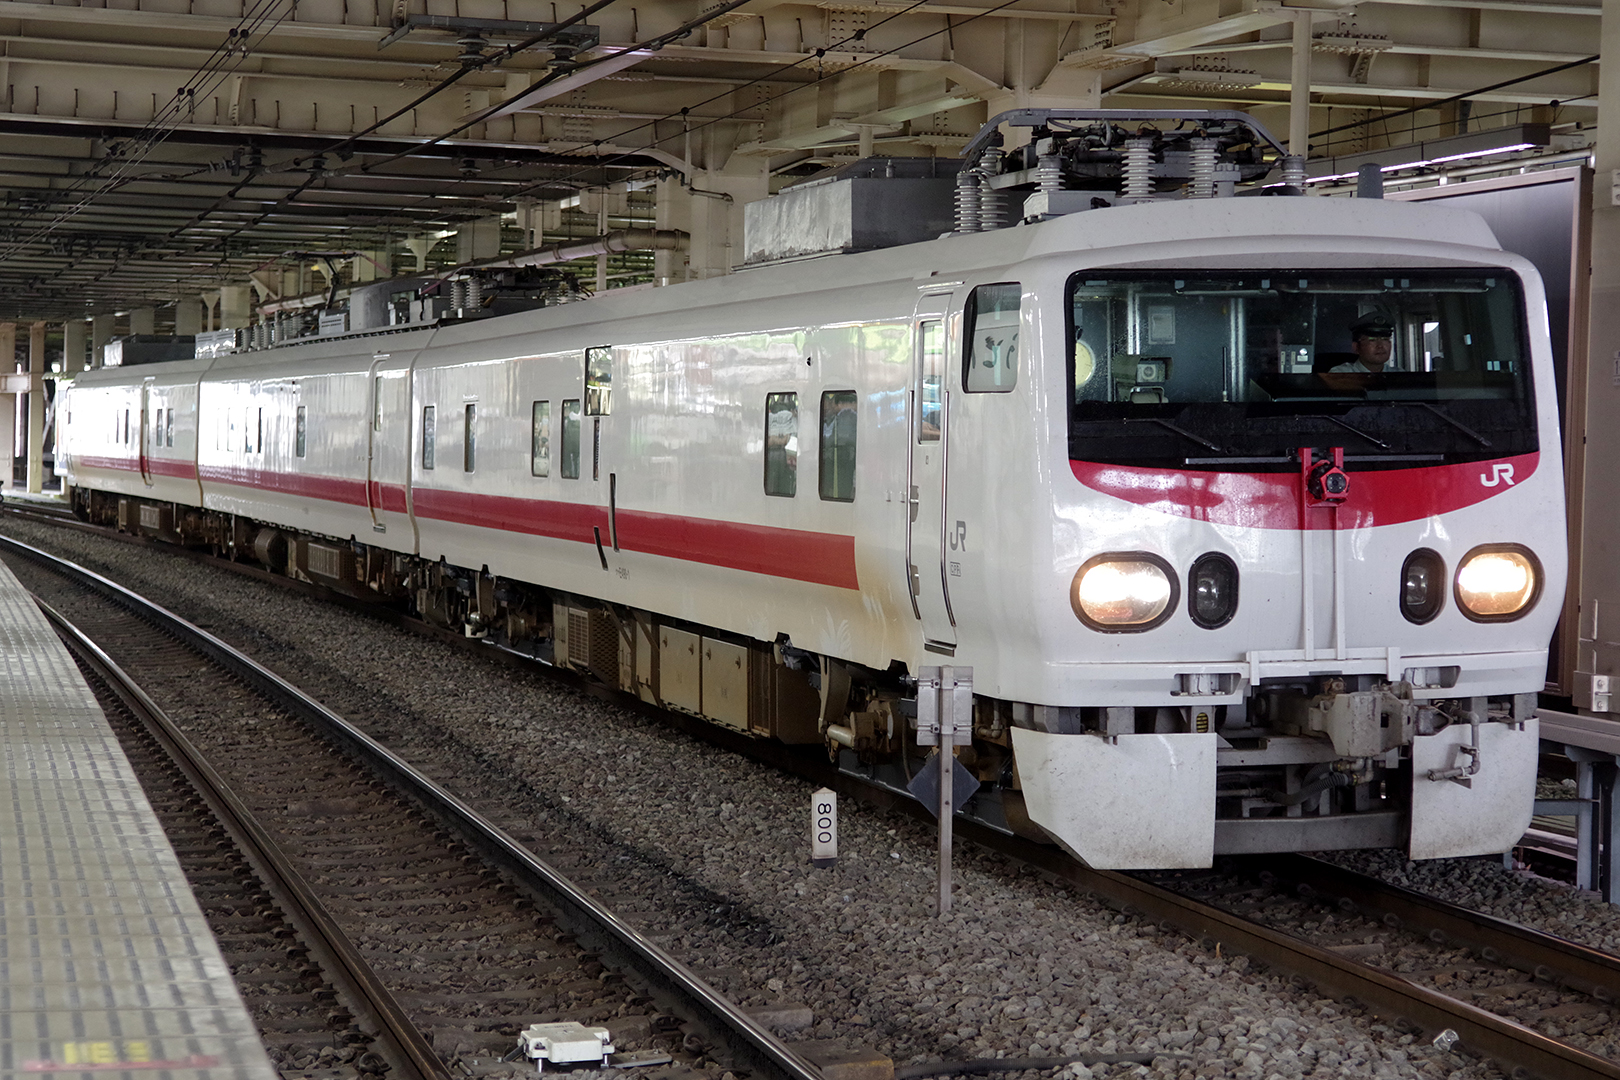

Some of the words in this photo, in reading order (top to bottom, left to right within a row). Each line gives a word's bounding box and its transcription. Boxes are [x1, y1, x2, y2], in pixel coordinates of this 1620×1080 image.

[1480, 463, 1515, 487] JR
[950, 520, 966, 552] JR
[817, 803, 832, 843] 800
